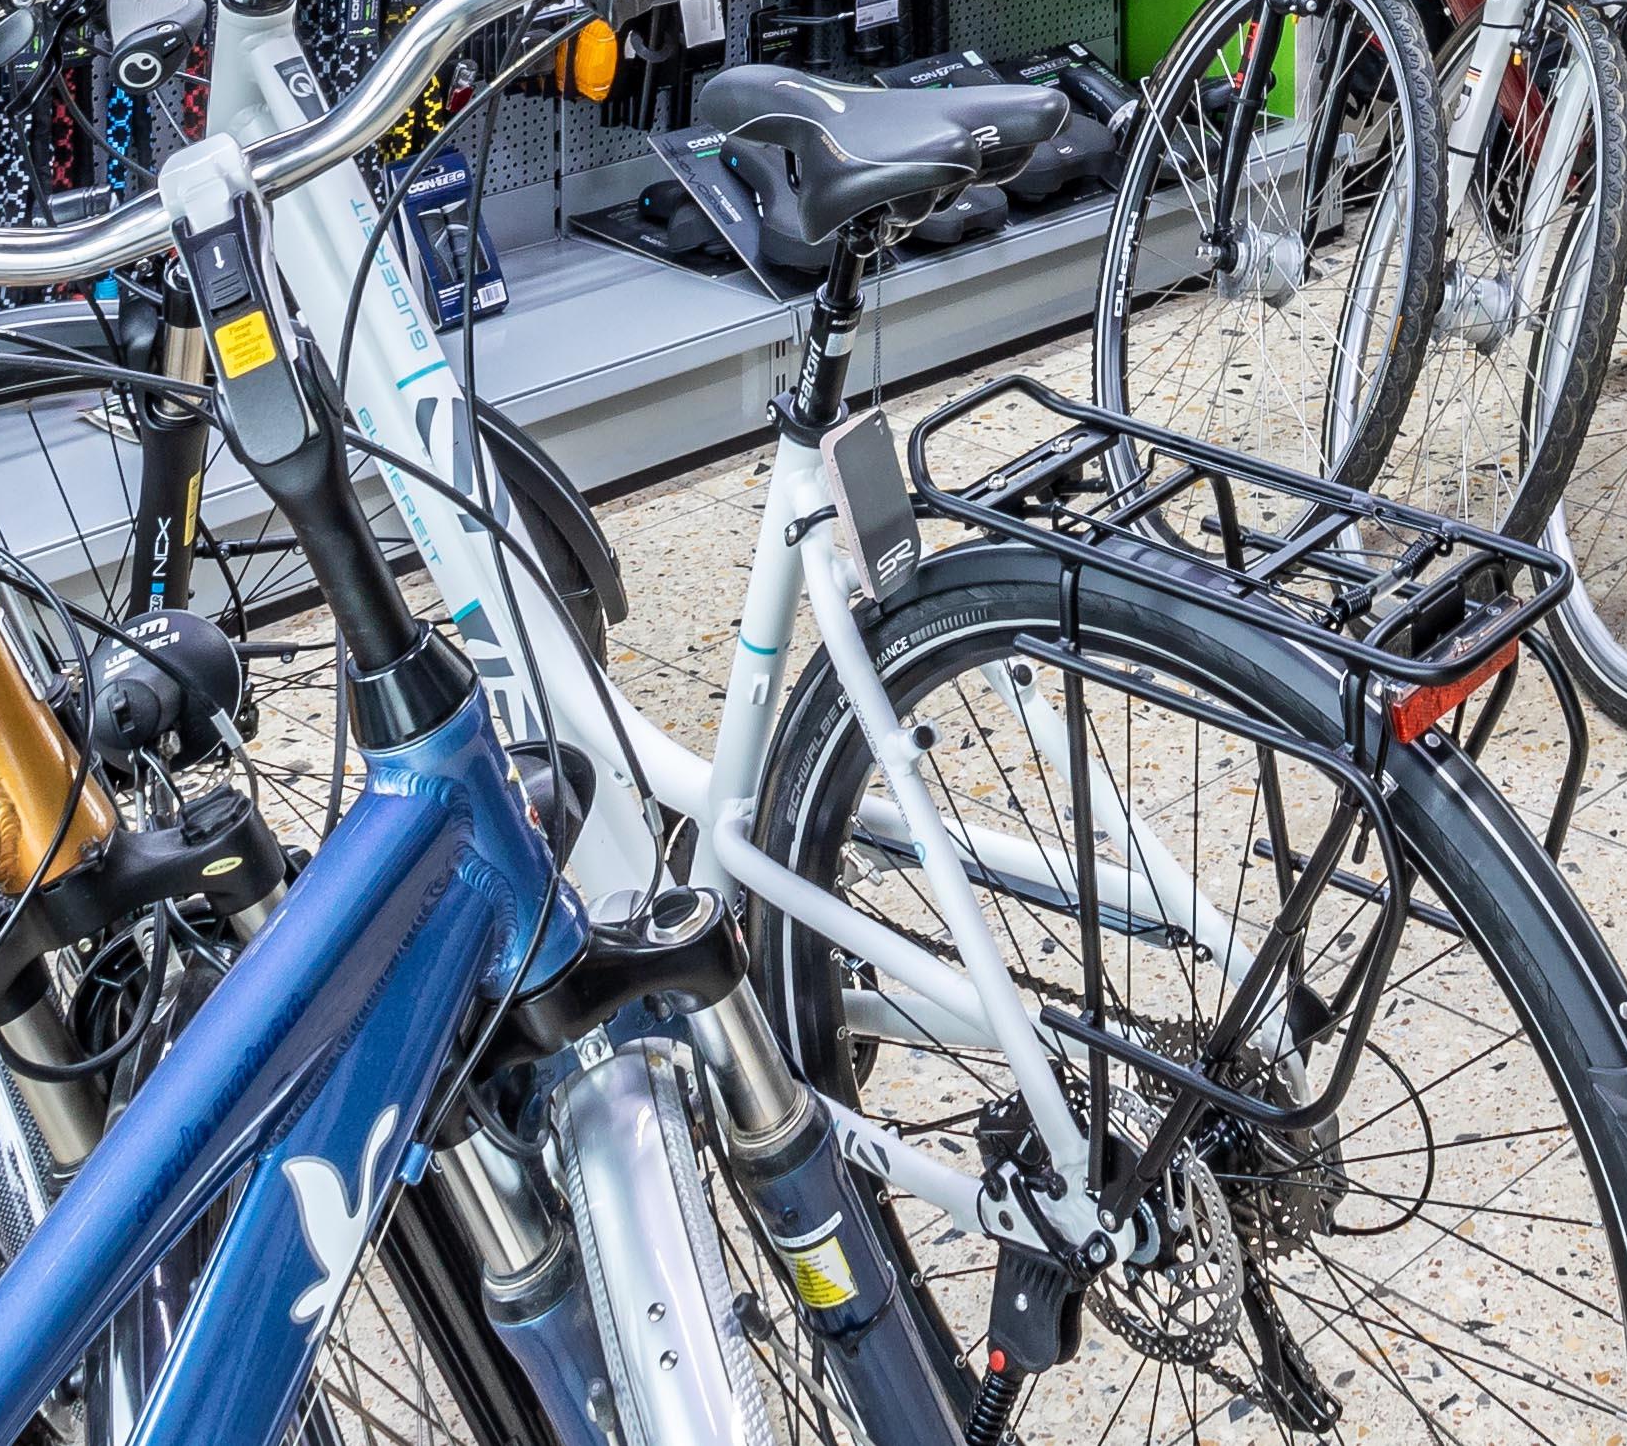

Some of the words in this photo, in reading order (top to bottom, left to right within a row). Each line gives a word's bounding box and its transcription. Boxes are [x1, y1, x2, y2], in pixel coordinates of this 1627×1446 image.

[349, 197, 432, 351] GUDEREIT
[794, 333, 824, 414] satori
[152, 517, 173, 578] NCX
